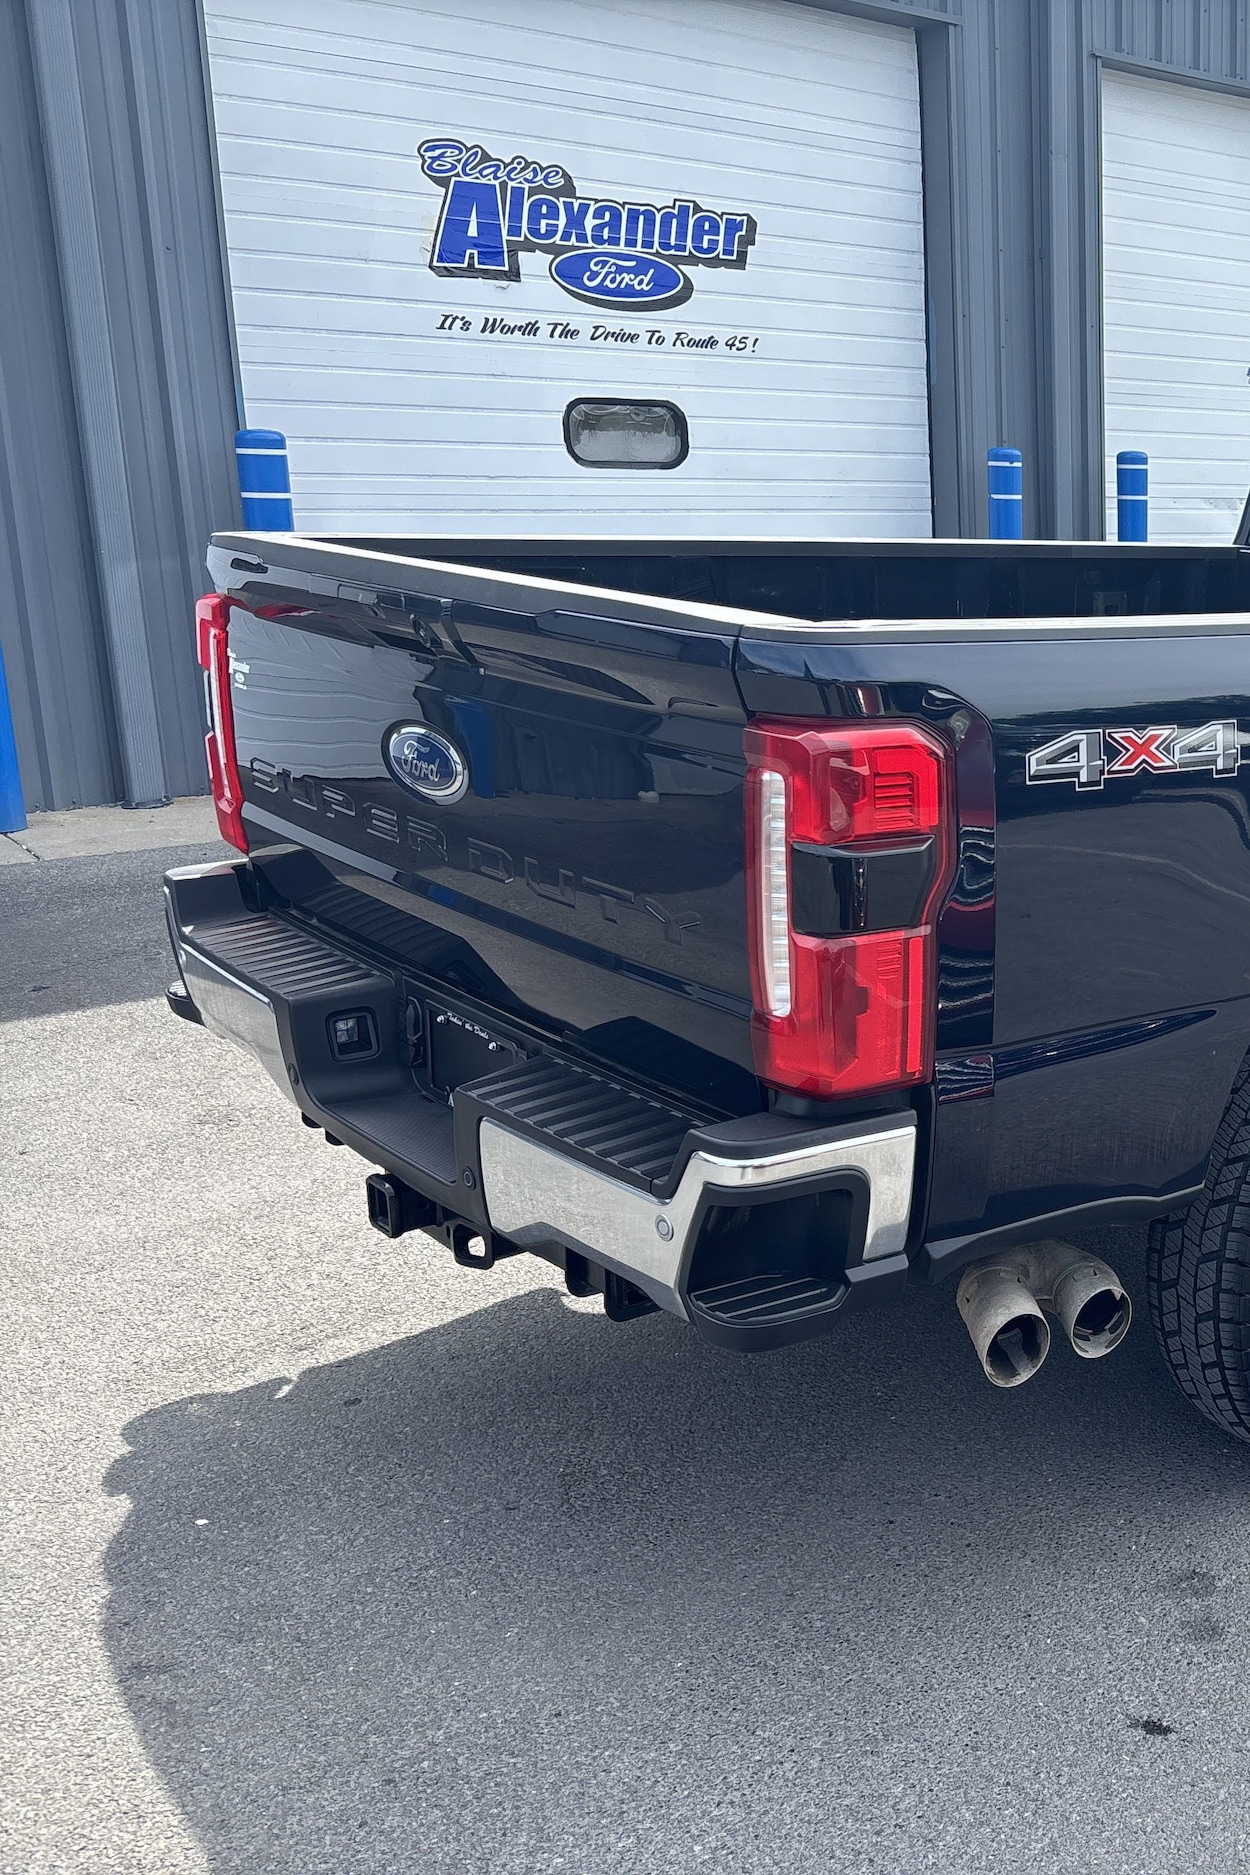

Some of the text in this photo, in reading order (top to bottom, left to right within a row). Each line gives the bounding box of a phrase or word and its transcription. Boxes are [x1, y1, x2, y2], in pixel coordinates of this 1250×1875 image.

[421, 140, 565, 188] Blaise
[432, 177, 748, 271] Alexander
[582, 256, 655, 292] Ford
[435, 313, 471, 332] It's
[480, 316, 540, 338] Worth
[547, 322, 580, 340] The
[590, 324, 640, 345] Drive
[644, 329, 666, 346] To
[671, 331, 719, 351] Route
[402, 740, 440, 782] Ford
[1026, 719, 1240, 791] 4X4
[249, 756, 700, 945] SUPER DUTY
